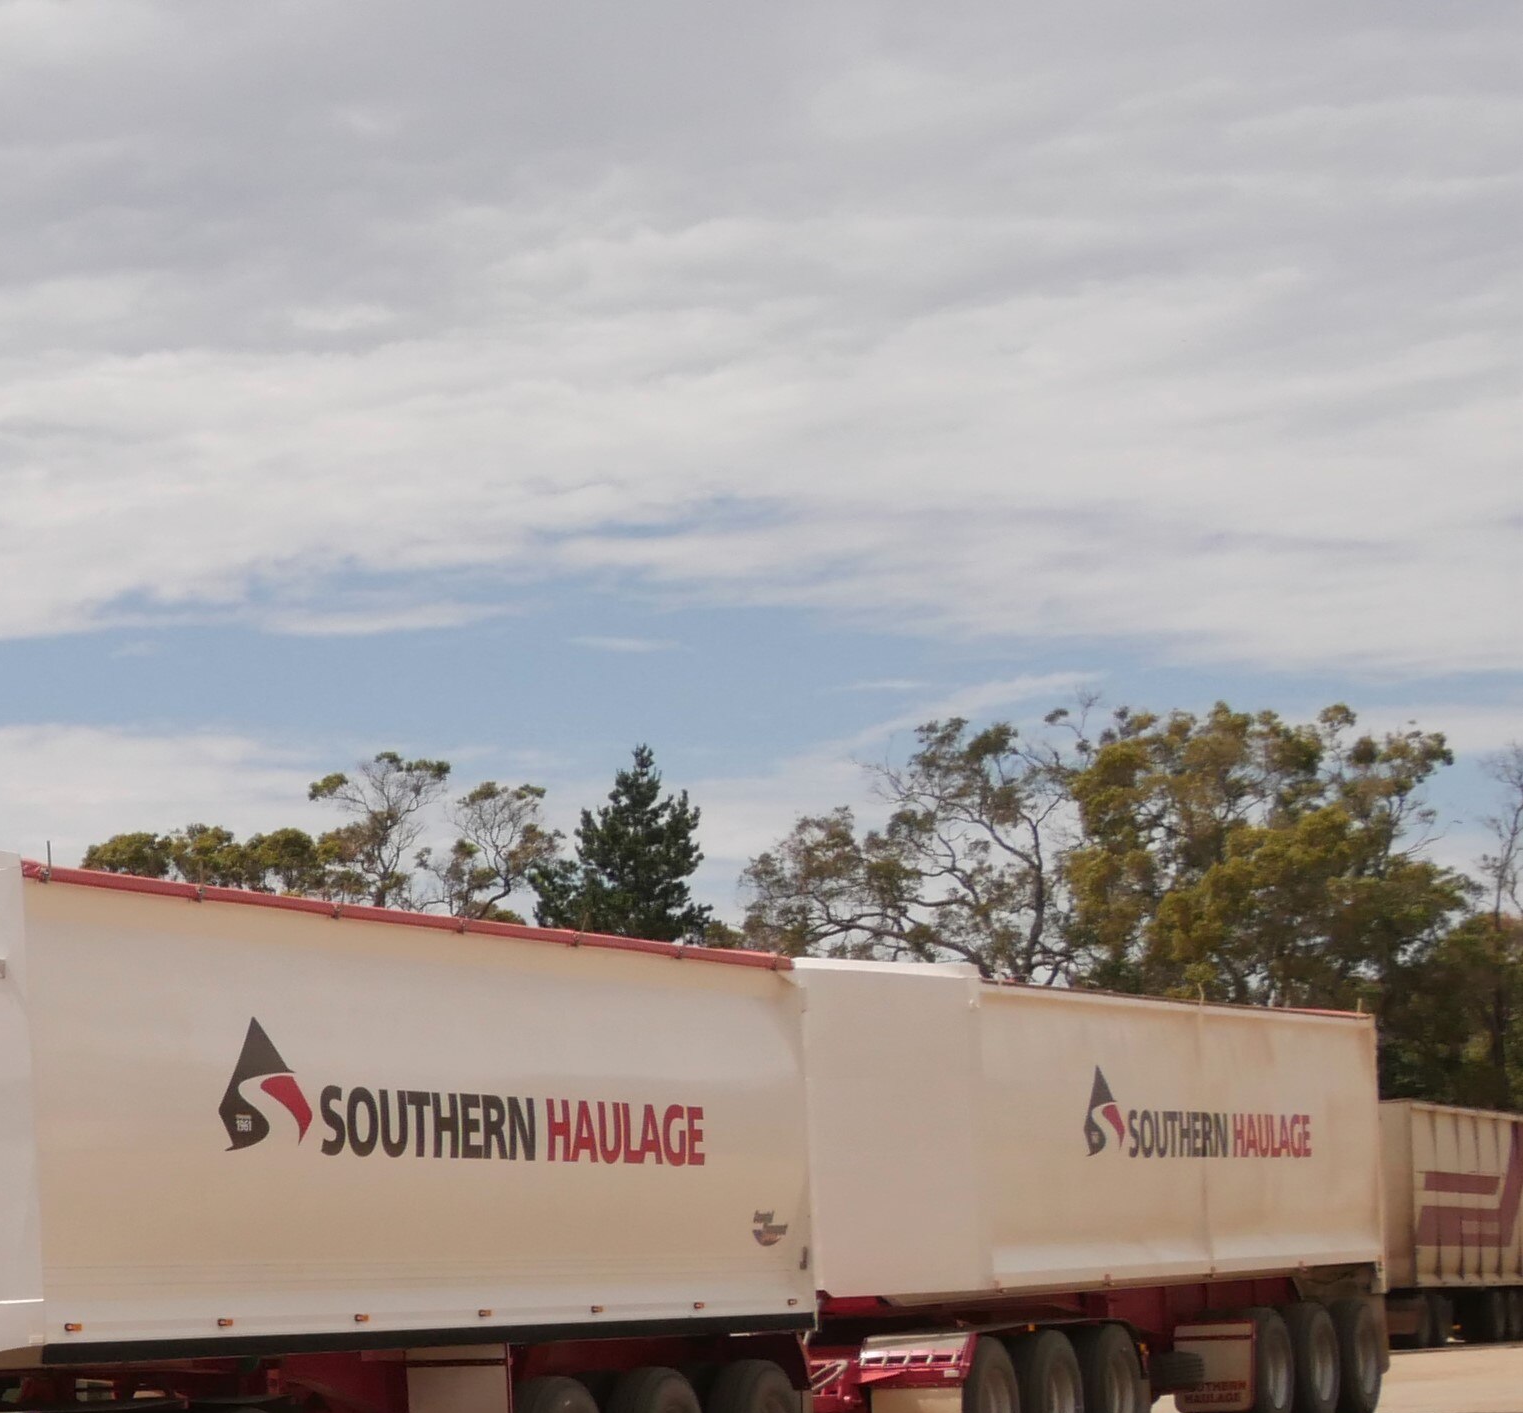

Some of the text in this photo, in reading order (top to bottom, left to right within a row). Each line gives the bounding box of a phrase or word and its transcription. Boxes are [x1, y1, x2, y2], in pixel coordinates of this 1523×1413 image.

[320, 1085, 706, 1166] SOUTHERN HAULAGE
[1128, 1109, 1312, 1158] SOUTHERN HAULAGE
